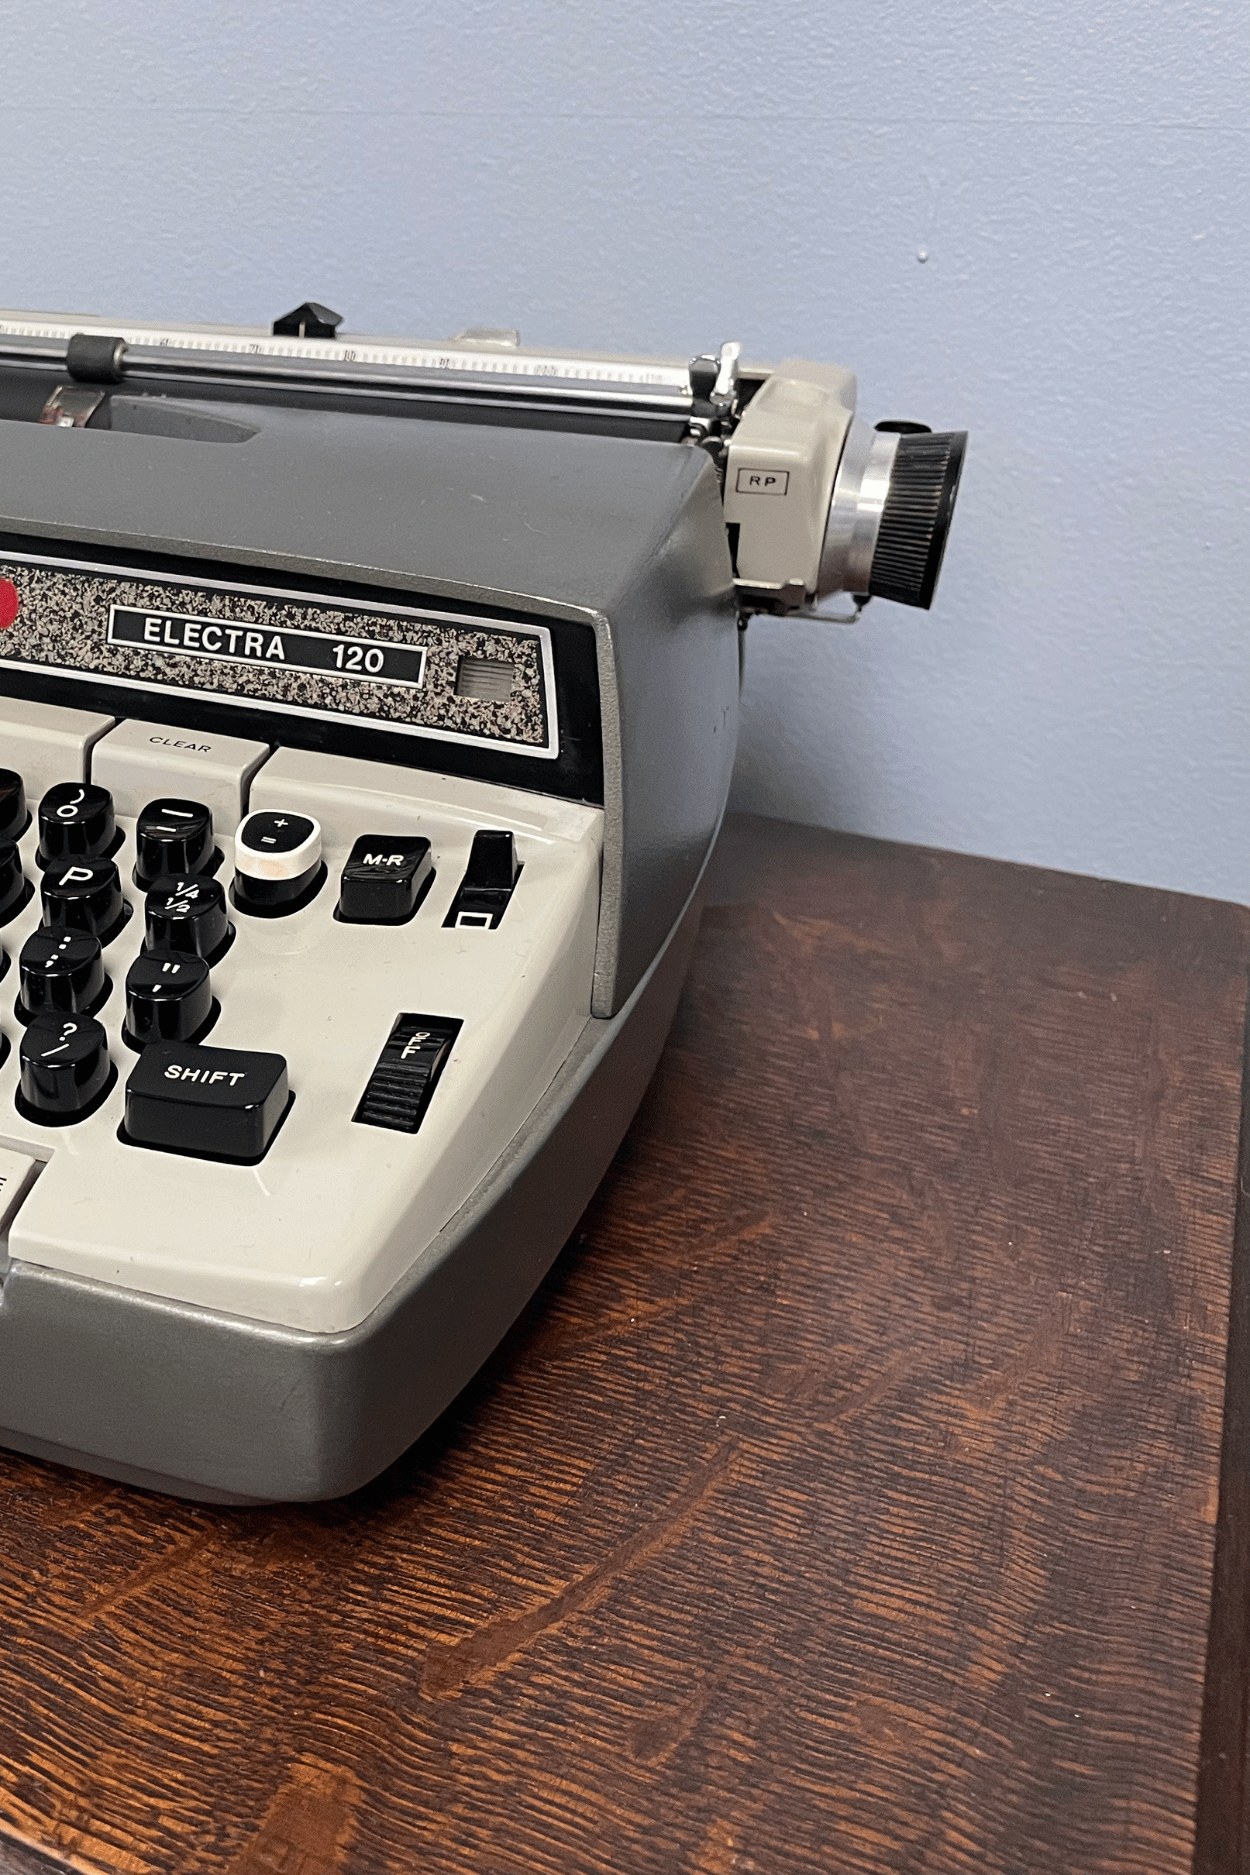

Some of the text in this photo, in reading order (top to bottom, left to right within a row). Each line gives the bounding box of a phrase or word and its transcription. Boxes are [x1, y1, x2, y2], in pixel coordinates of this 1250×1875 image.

[144, 617, 385, 674] ELECTRA 120
[148, 735, 213, 754] CLEAR
[274, 818, 289, 828] +
[260, 836, 277, 844] =
[362, 853, 404, 866] M-R
[58, 866, 94, 886] P
[59, 1022, 78, 1042] ?
[400, 1032, 431, 1059] OFF
[164, 1064, 245, 1086] SHIFT
